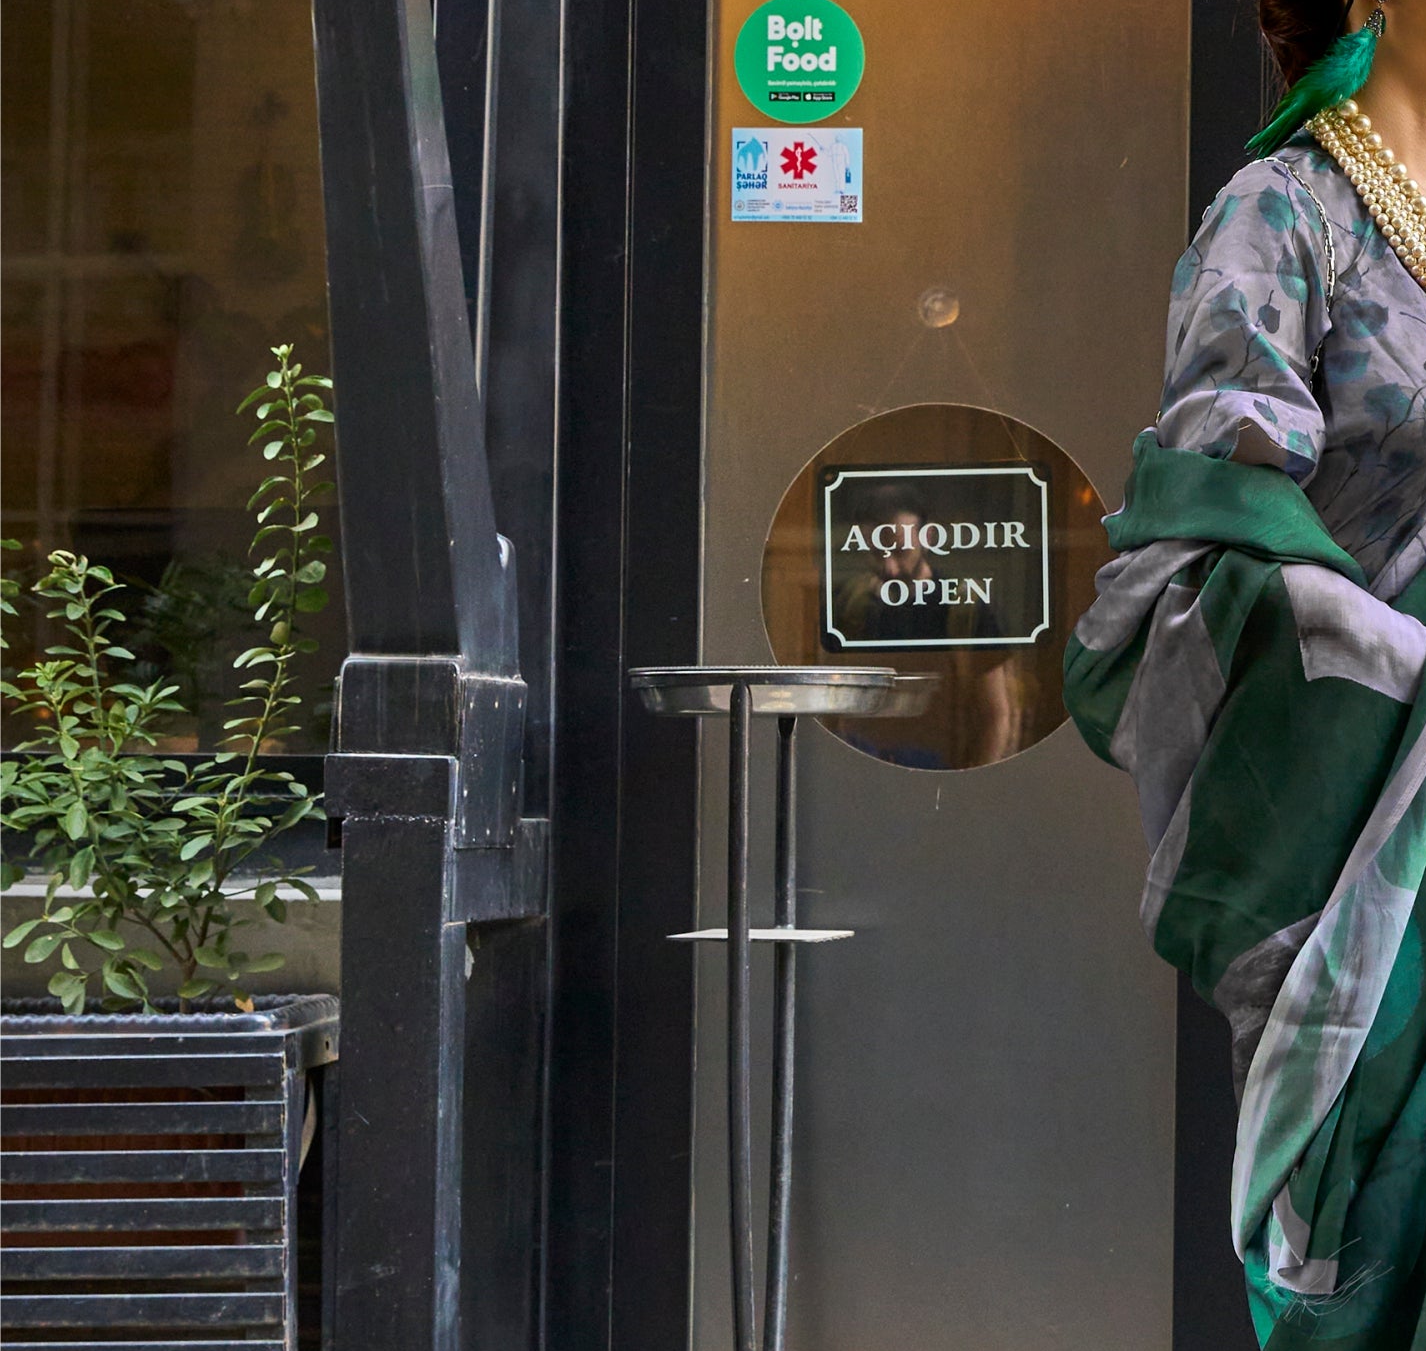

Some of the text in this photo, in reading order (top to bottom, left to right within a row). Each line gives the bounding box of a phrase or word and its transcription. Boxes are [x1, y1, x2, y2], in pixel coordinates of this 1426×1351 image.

[767, 15, 823, 41] Bolt
[767, 46, 837, 72] Food
[736, 173, 768, 182] PARLAQ
[841, 521, 1030, 558] AÇIQDIR
[880, 577, 993, 606] OPEN
